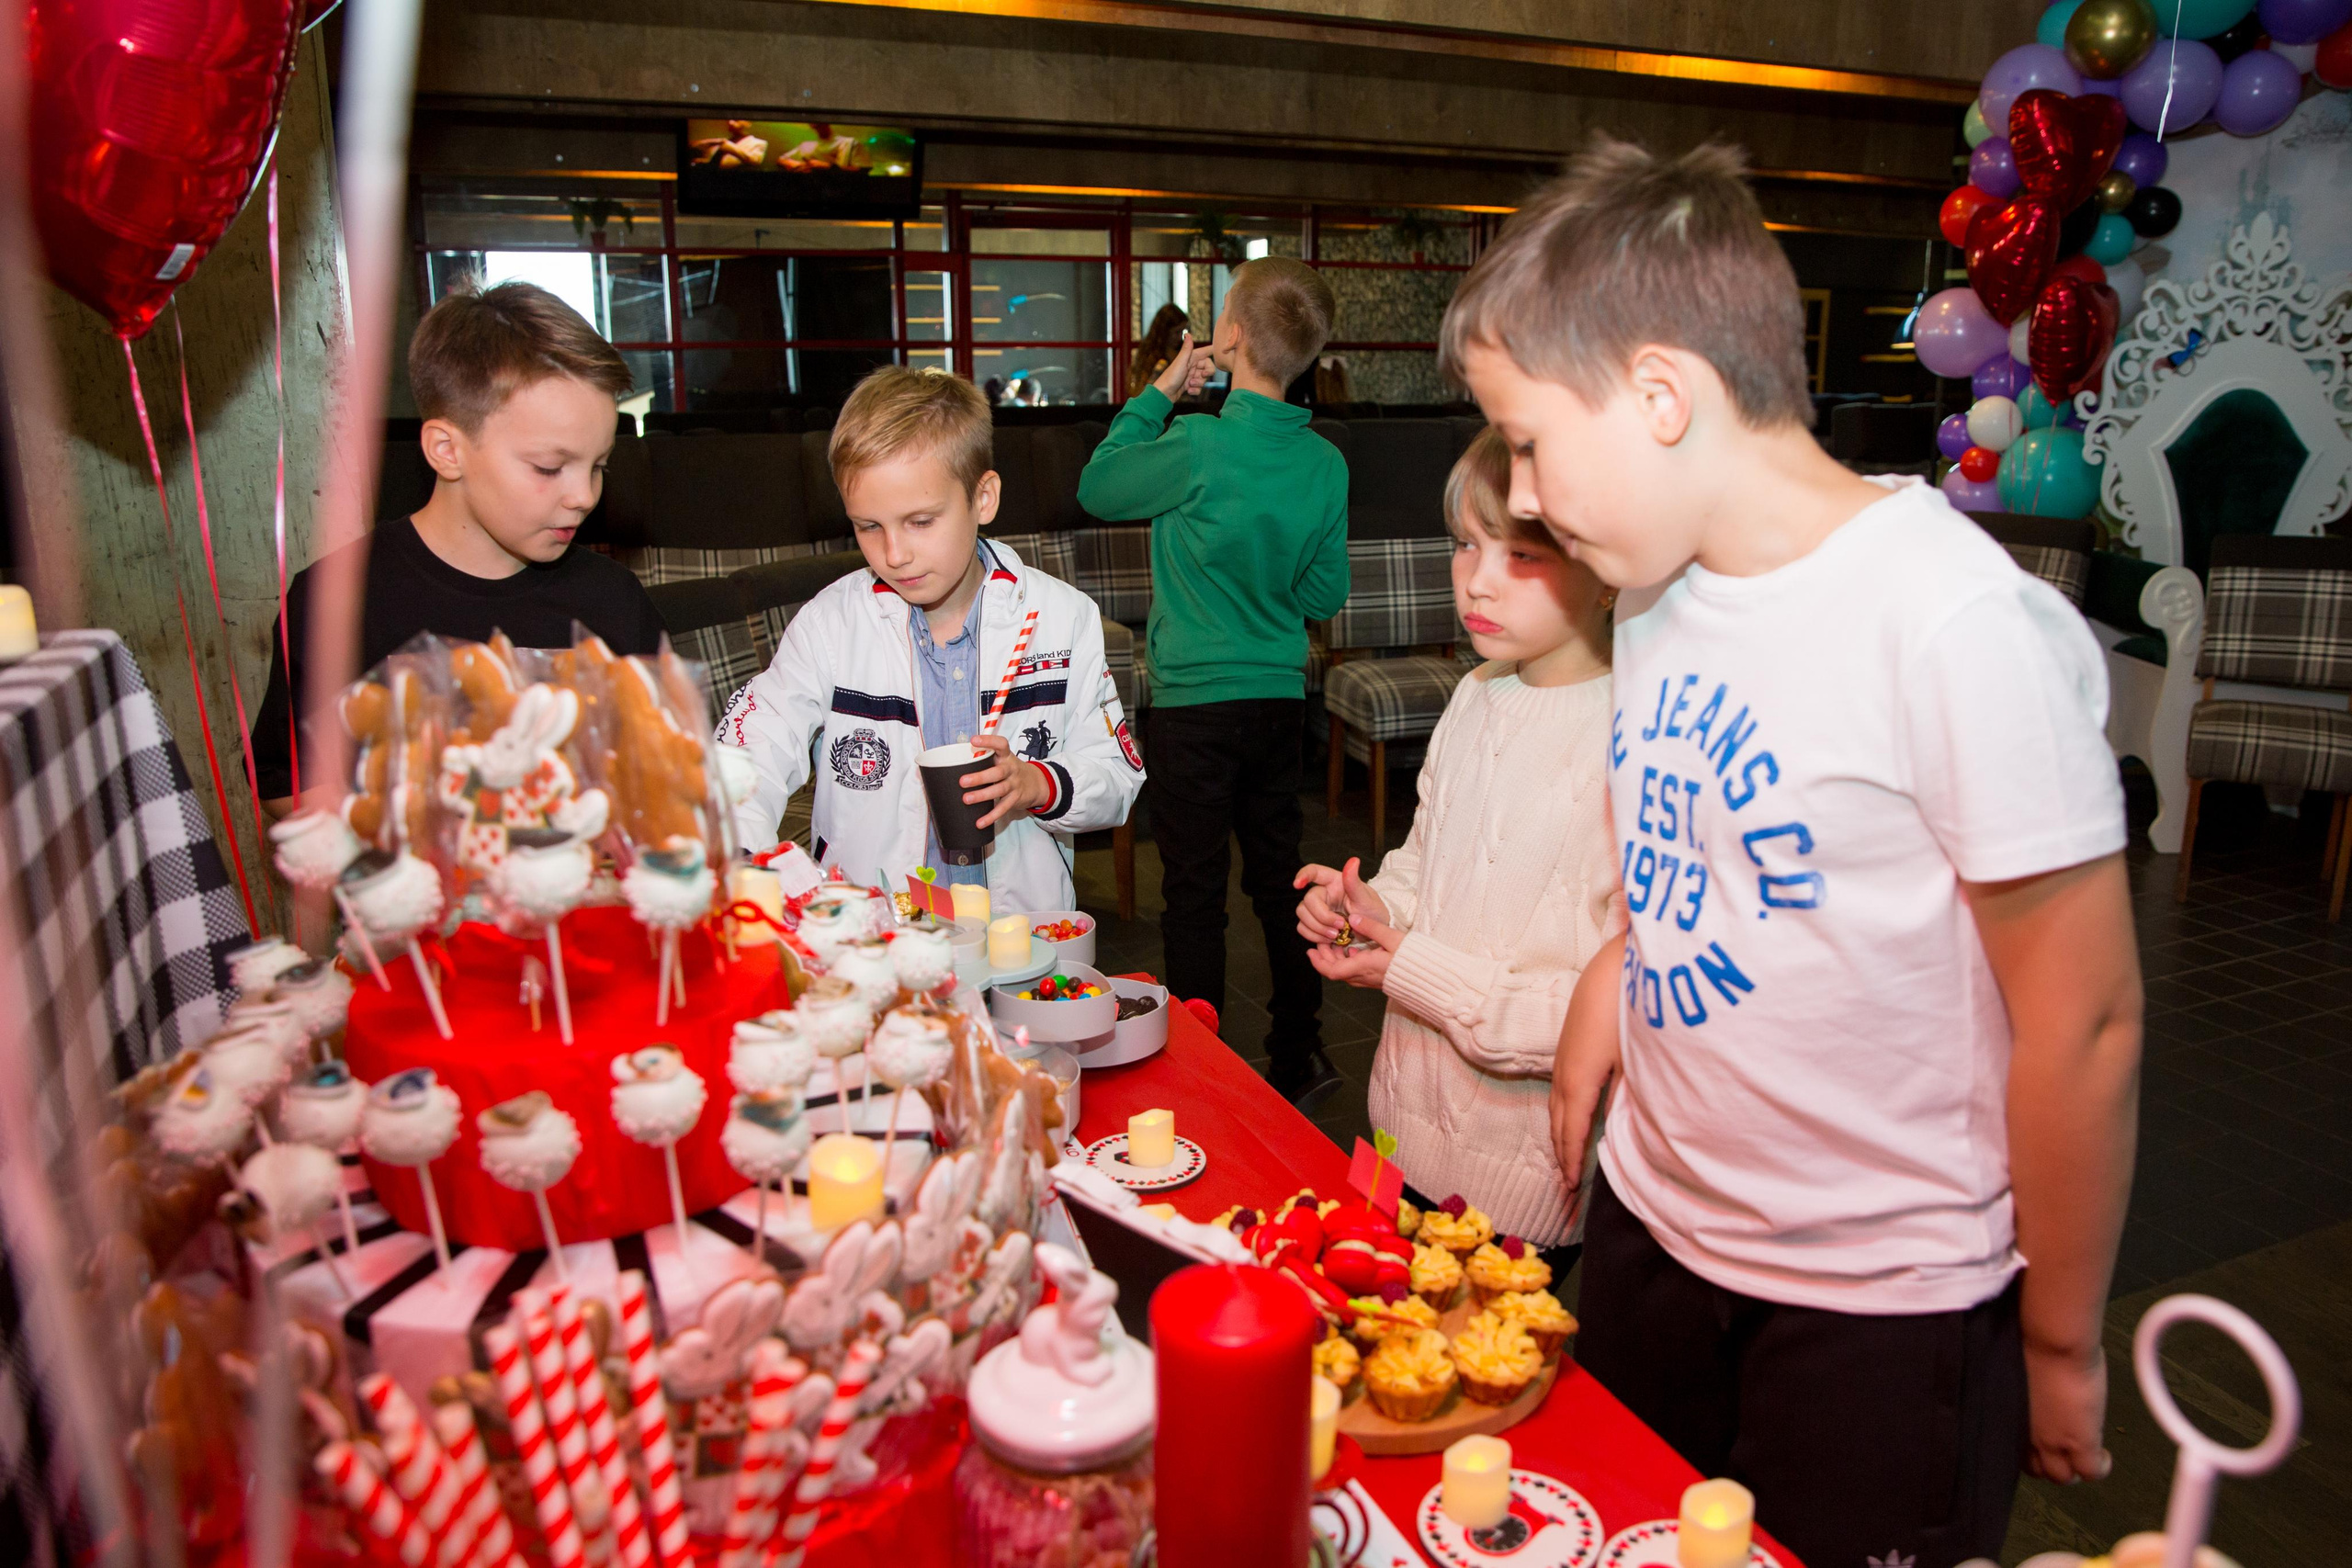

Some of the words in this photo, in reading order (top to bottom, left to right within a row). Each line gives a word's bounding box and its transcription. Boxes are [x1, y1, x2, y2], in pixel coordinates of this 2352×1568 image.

[1018, 655, 1035, 665] ORS
[1036, 651, 1055, 660] land
[1641, 674, 1781, 812] JEANS
[1638, 765, 1704, 852] EST.
[1623, 840, 1708, 932] 1973
